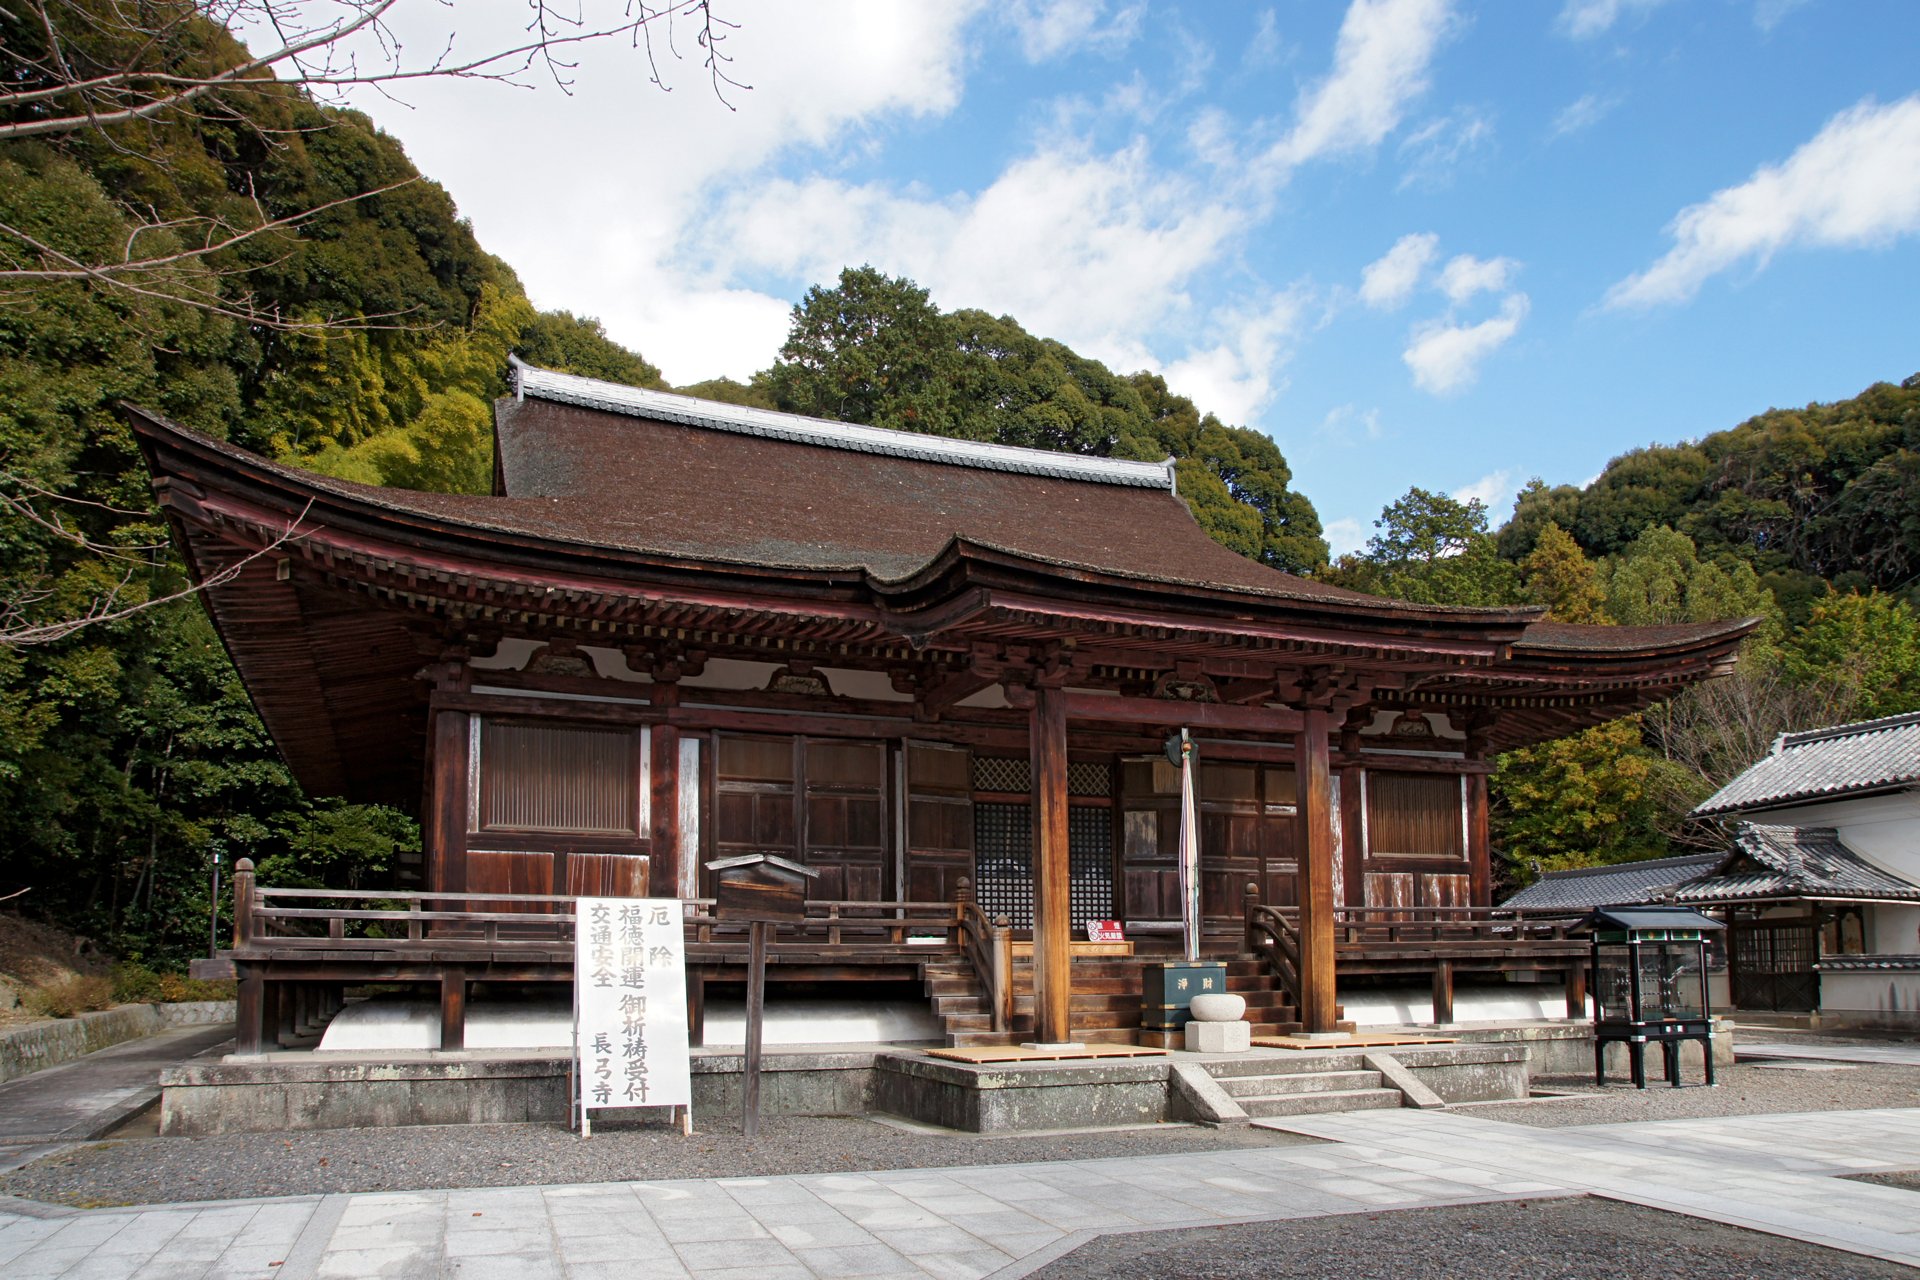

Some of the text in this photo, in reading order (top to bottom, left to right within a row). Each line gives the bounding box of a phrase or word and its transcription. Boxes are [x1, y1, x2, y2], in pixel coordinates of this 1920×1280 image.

[590, 903, 617, 988] 交通安全
[591, 1032, 613, 1105] 長弓寺
